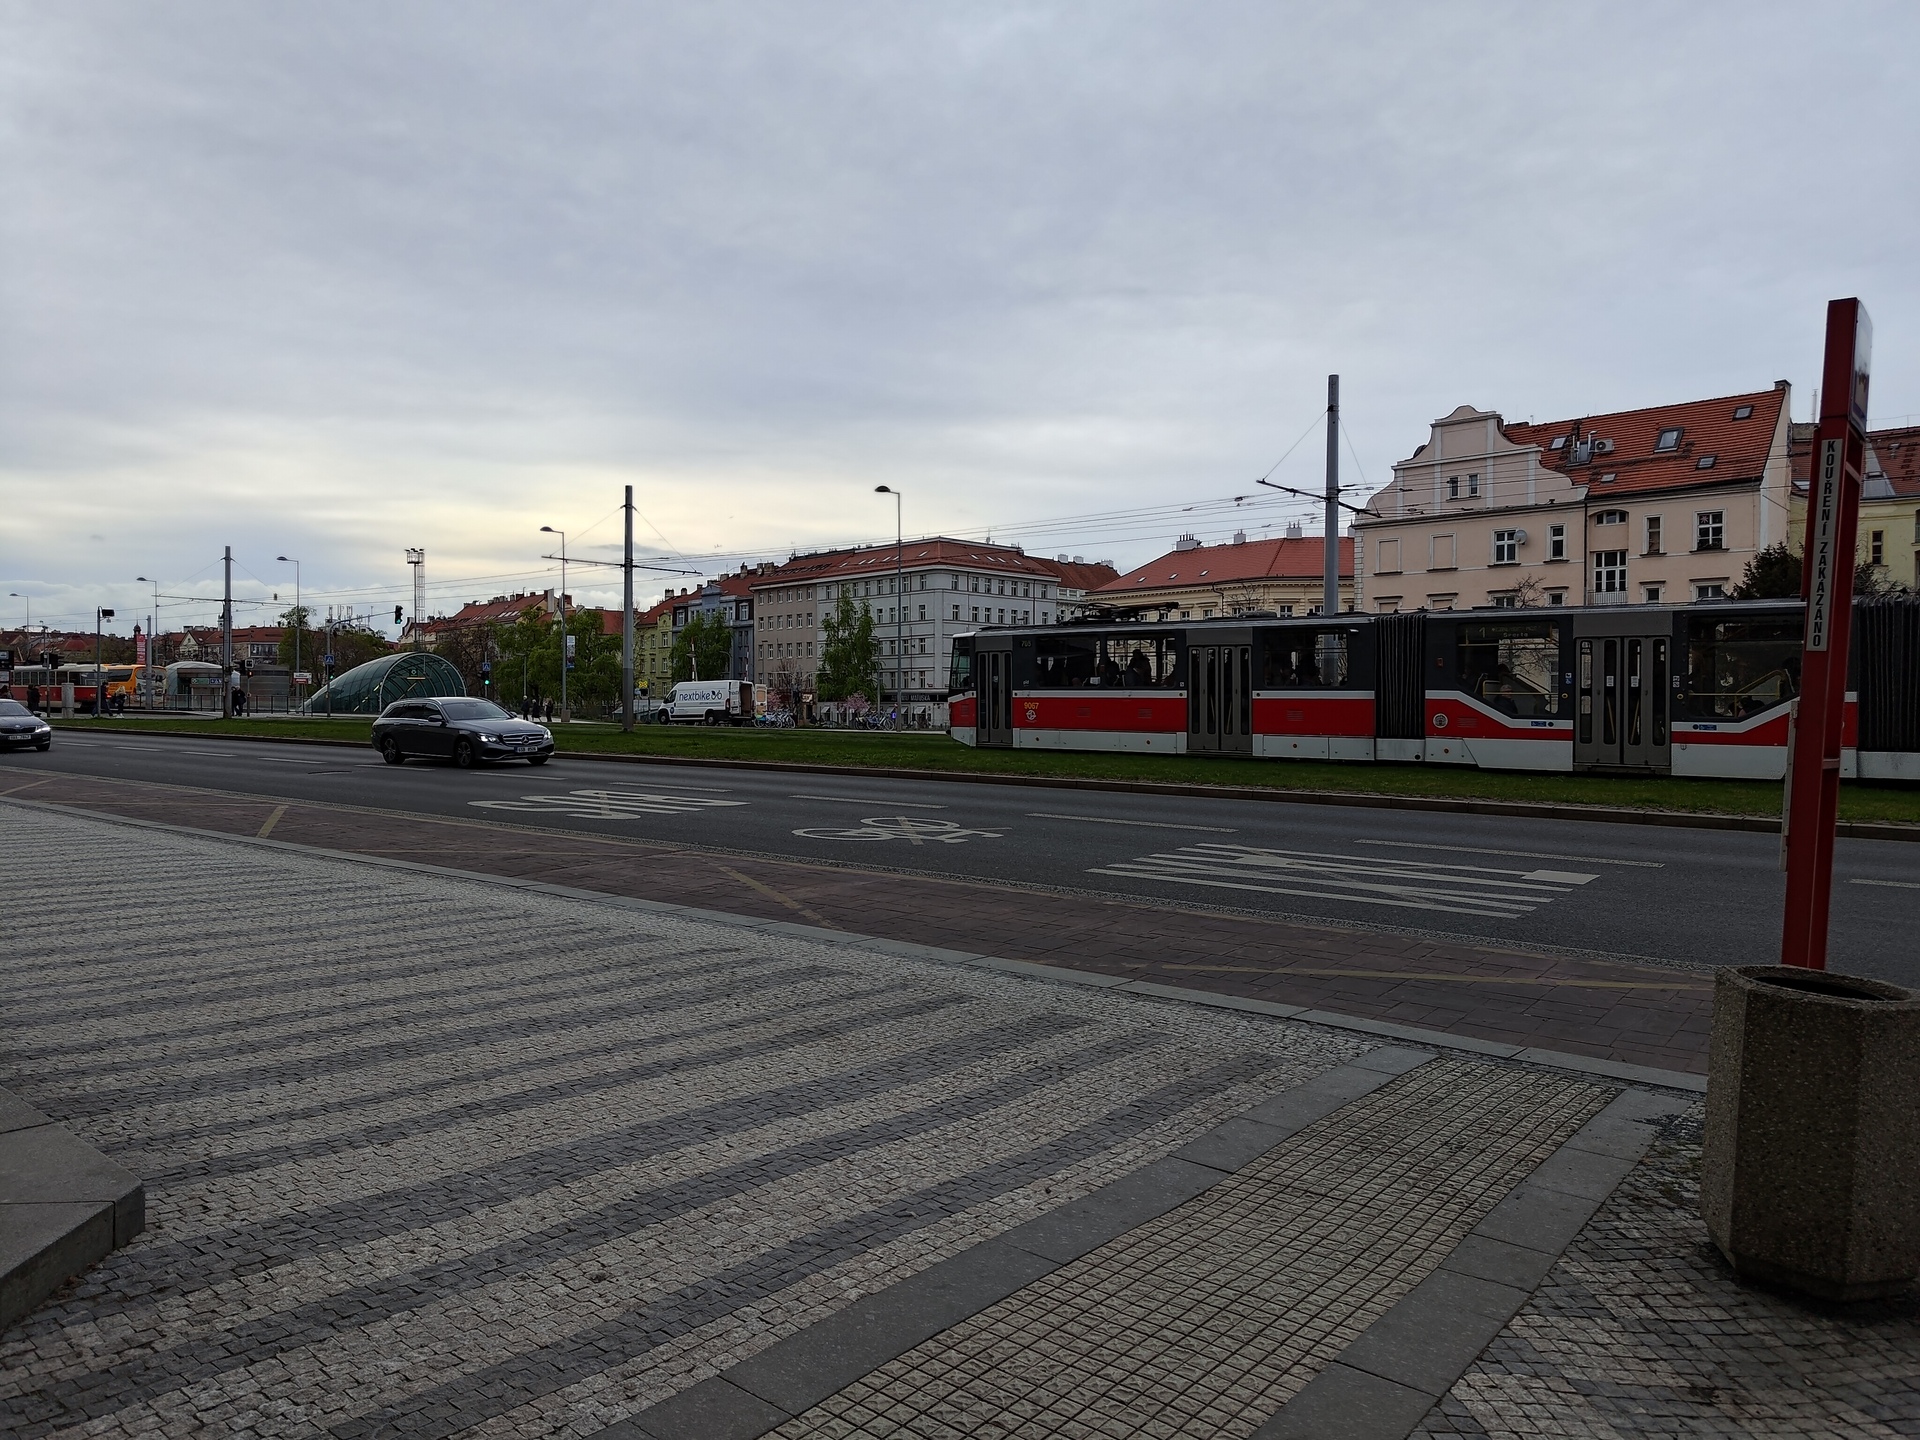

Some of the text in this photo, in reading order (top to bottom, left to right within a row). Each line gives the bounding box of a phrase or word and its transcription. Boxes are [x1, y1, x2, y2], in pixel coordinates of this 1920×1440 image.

[1812, 440, 1836, 647] KOUŘENÍ ZAKÁZÁNO
[679, 690, 710, 701] nextbike
[1024, 702, 1039, 710] 9067
[467, 789, 752, 820] BUS
